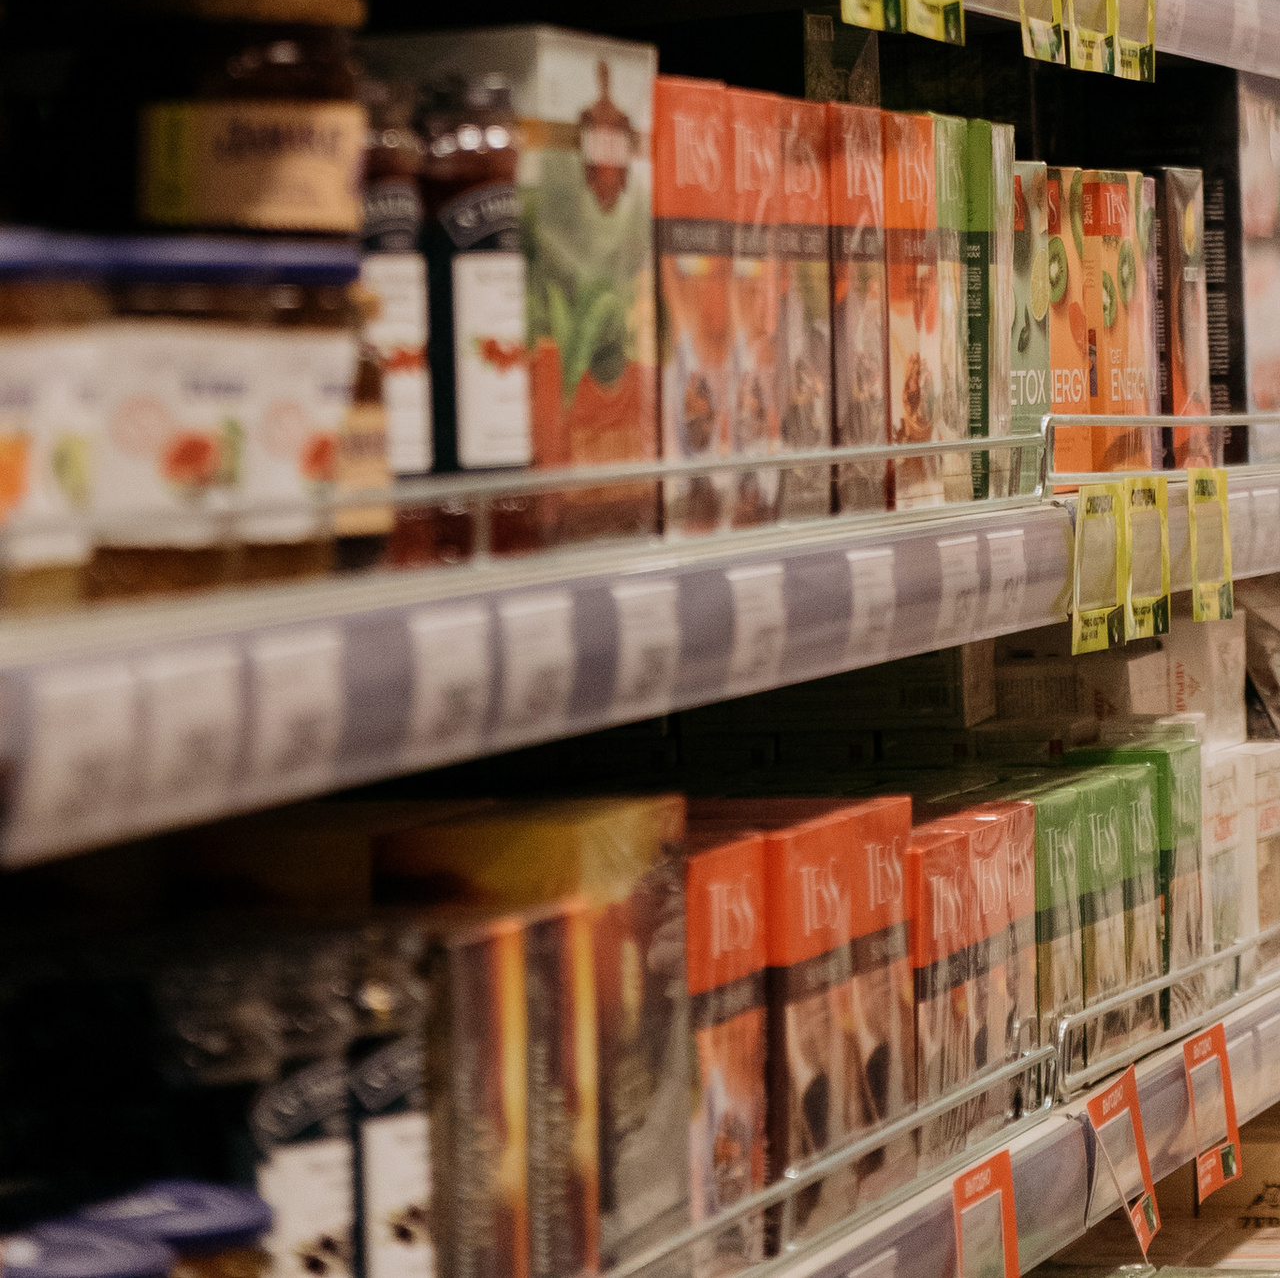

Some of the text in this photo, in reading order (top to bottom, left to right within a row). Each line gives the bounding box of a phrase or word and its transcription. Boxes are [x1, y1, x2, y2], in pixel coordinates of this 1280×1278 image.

[897, 135, 929, 208] TESS
[1105, 187, 1128, 227] TESS
[1010, 369, 1047, 407] ETOX
[1110, 348, 1122, 365] GET
[864, 836, 904, 912] TESS
[1005, 834, 1033, 904] TESS
[1045, 820, 1077, 887] TESS
[1088, 807, 1119, 871] TESS
[708, 874, 755, 960] TESS
[799, 857, 842, 937] TESS
[929, 866, 963, 941] TESS
[973, 850, 1002, 922] TESS
